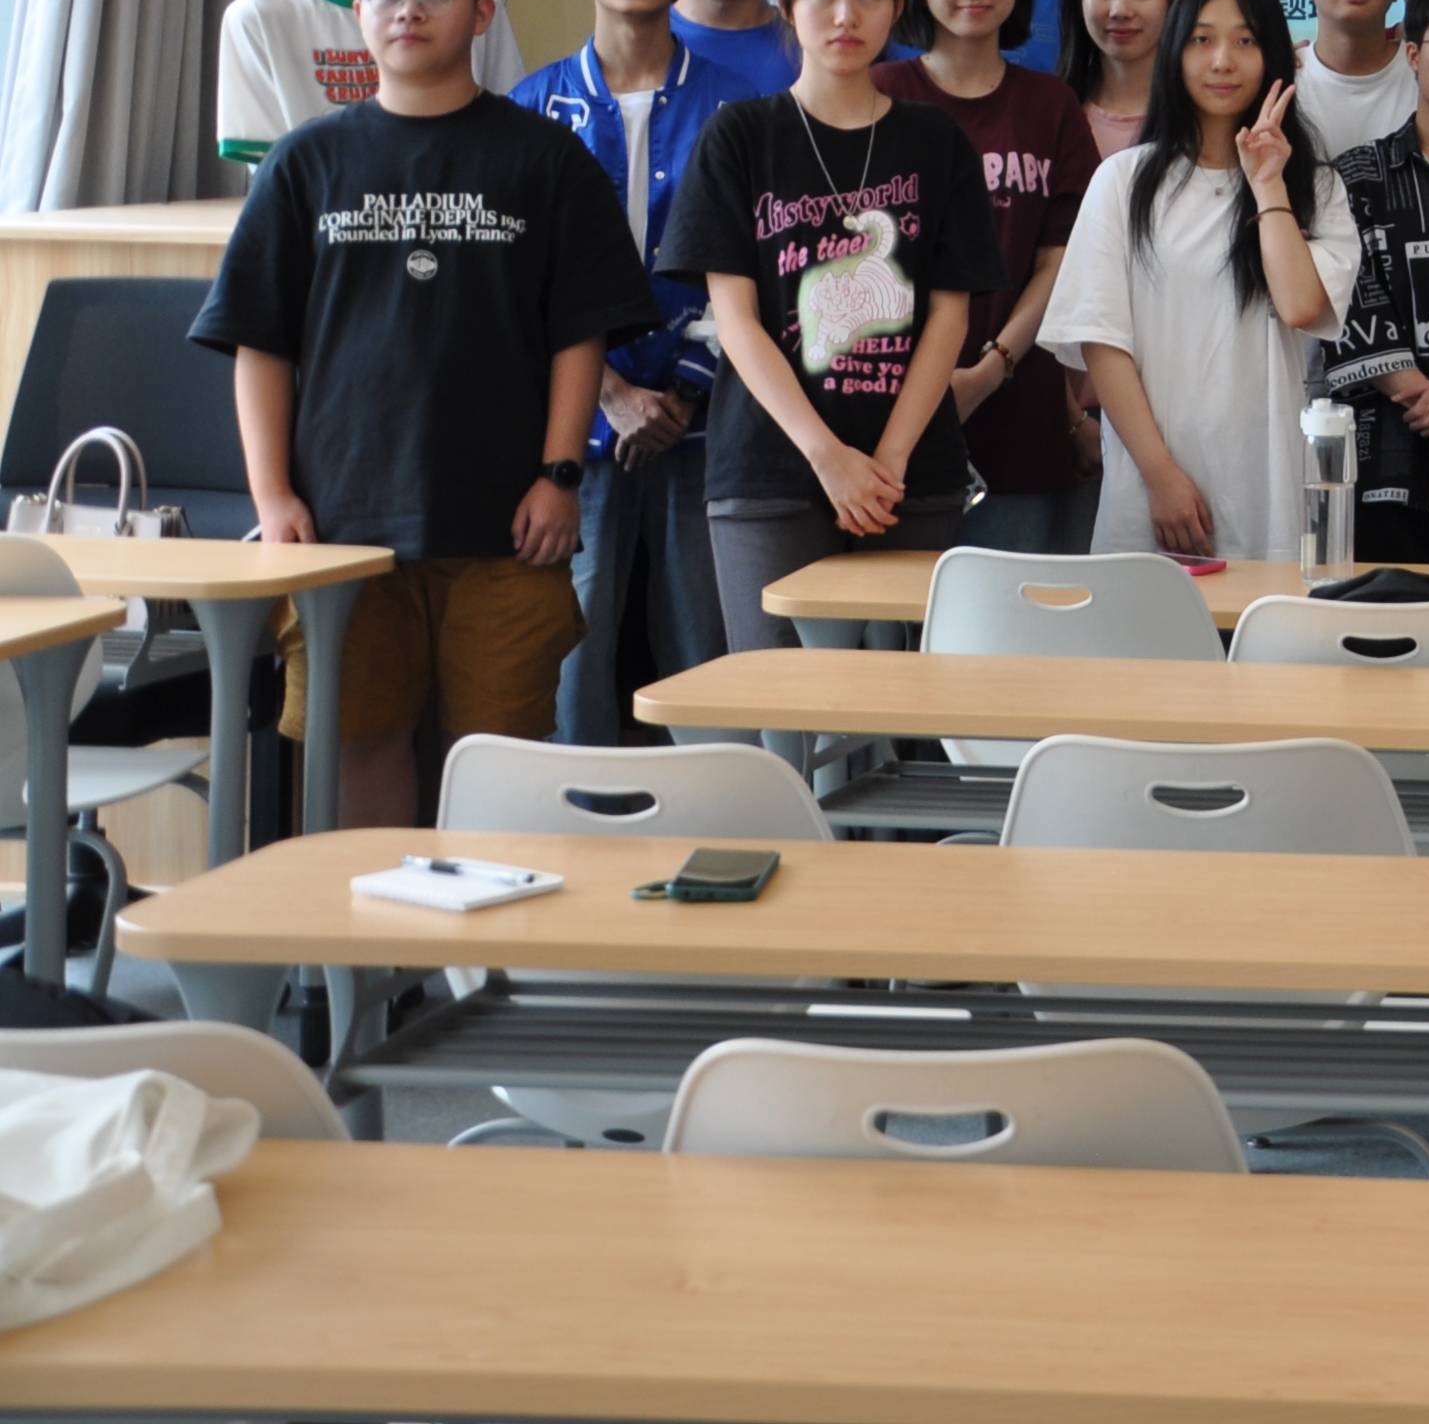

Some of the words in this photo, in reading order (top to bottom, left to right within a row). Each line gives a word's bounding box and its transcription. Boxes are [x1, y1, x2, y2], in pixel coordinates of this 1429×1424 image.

[362, 192, 484, 211] PALLADIUM
[429, 209, 498, 227] DEPUIS
[327, 225, 399, 245] Founded
[400, 225, 417, 241] in
[419, 226, 463, 245] Lyon,
[464, 224, 516, 243] France
[777, 241, 809, 277] the
[816, 231, 875, 264] tiger
[830, 355, 873, 374] Give
[878, 361, 906, 378] yo
